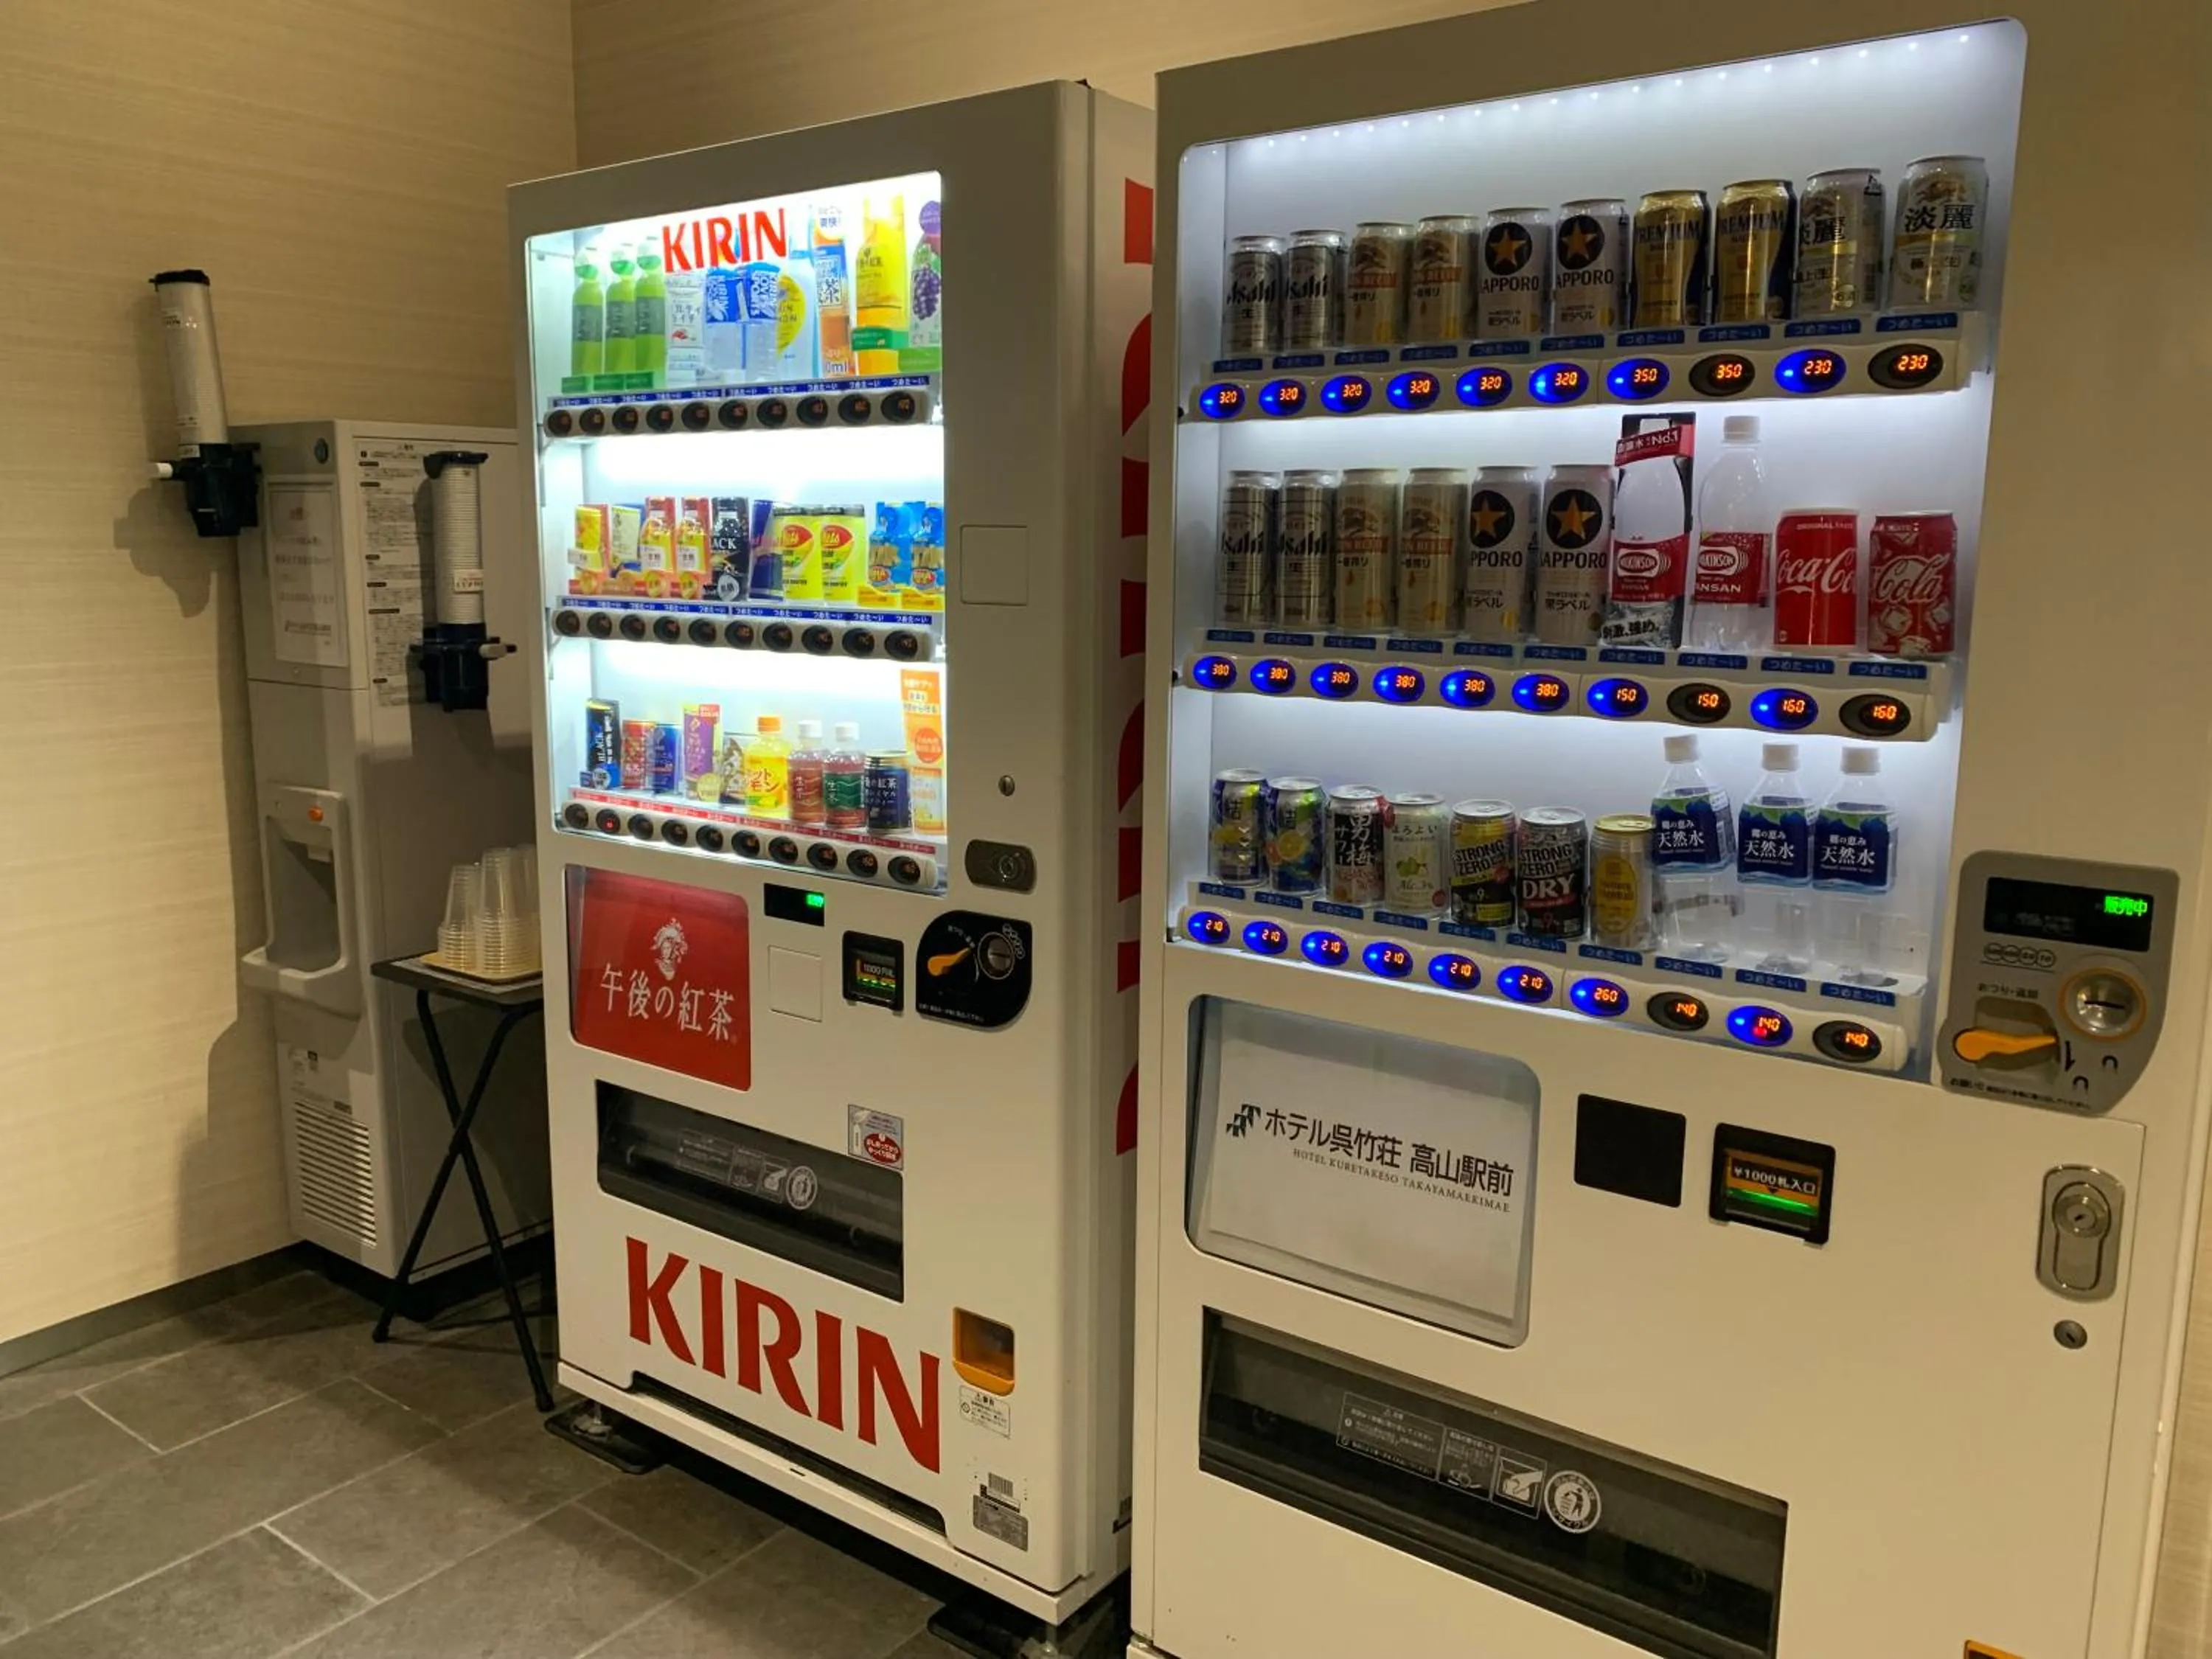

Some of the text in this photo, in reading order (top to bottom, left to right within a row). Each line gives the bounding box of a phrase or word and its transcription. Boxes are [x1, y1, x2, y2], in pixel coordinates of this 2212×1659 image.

[1905, 204, 1975, 232] 淡麗
[663, 208, 787, 273] KIRIN
[1481, 275, 1540, 293] APPORO
[1557, 269, 1614, 288] APPORO
[1804, 360, 1832, 375] 230
[1898, 355, 1928, 370] 230
[1555, 372, 1578, 386] 320
[1634, 368, 1657, 382] 350
[1717, 364, 1742, 379] 350
[1343, 384, 1363, 397] 320
[1411, 380, 1430, 394] 320
[1481, 376, 1502, 390] 320
[1220, 392, 1237, 403] 320
[1280, 387, 1298, 400] 320
[1545, 599, 1590, 611] 黒ラベル
[1212, 664, 1229, 676] 380
[1270, 668, 1287, 680] 380
[1332, 672, 1350, 684] 380
[1397, 675, 1415, 688] 380
[1464, 679, 1485, 692] 380
[1537, 684, 1559, 696] 380
[1617, 689, 1636, 701] 150
[1698, 695, 1719, 706] 150
[1783, 700, 1805, 713] 160
[1874, 706, 1896, 720] 160
[1335, 827, 1348, 863] サワー
[1347, 813, 1374, 866] 男梅
[1659, 831, 1705, 847] 天然水
[1453, 840, 1505, 862] STRONG
[1520, 844, 1573, 863] STRONG
[1745, 840, 1795, 859] 天然水
[1820, 846, 1876, 866] 天然水
[1457, 858, 1489, 876] ZERO
[1522, 874, 1574, 900] DRY
[601, 963, 734, 1041] 午後の紅茶
[1594, 987, 1618, 1003] 260
[1675, 1002, 1698, 1017] 140
[1759, 1017, 1781, 1032] 140
[1846, 1032, 1868, 1046] 140
[1265, 1109, 1514, 1197] ホテル呉竹荘 高山駅前
[1294, 1148, 1510, 1213] HOTEL KURETAKESO TAKAYAMAEKIMAE
[627, 1236, 940, 1474] KIRIN
